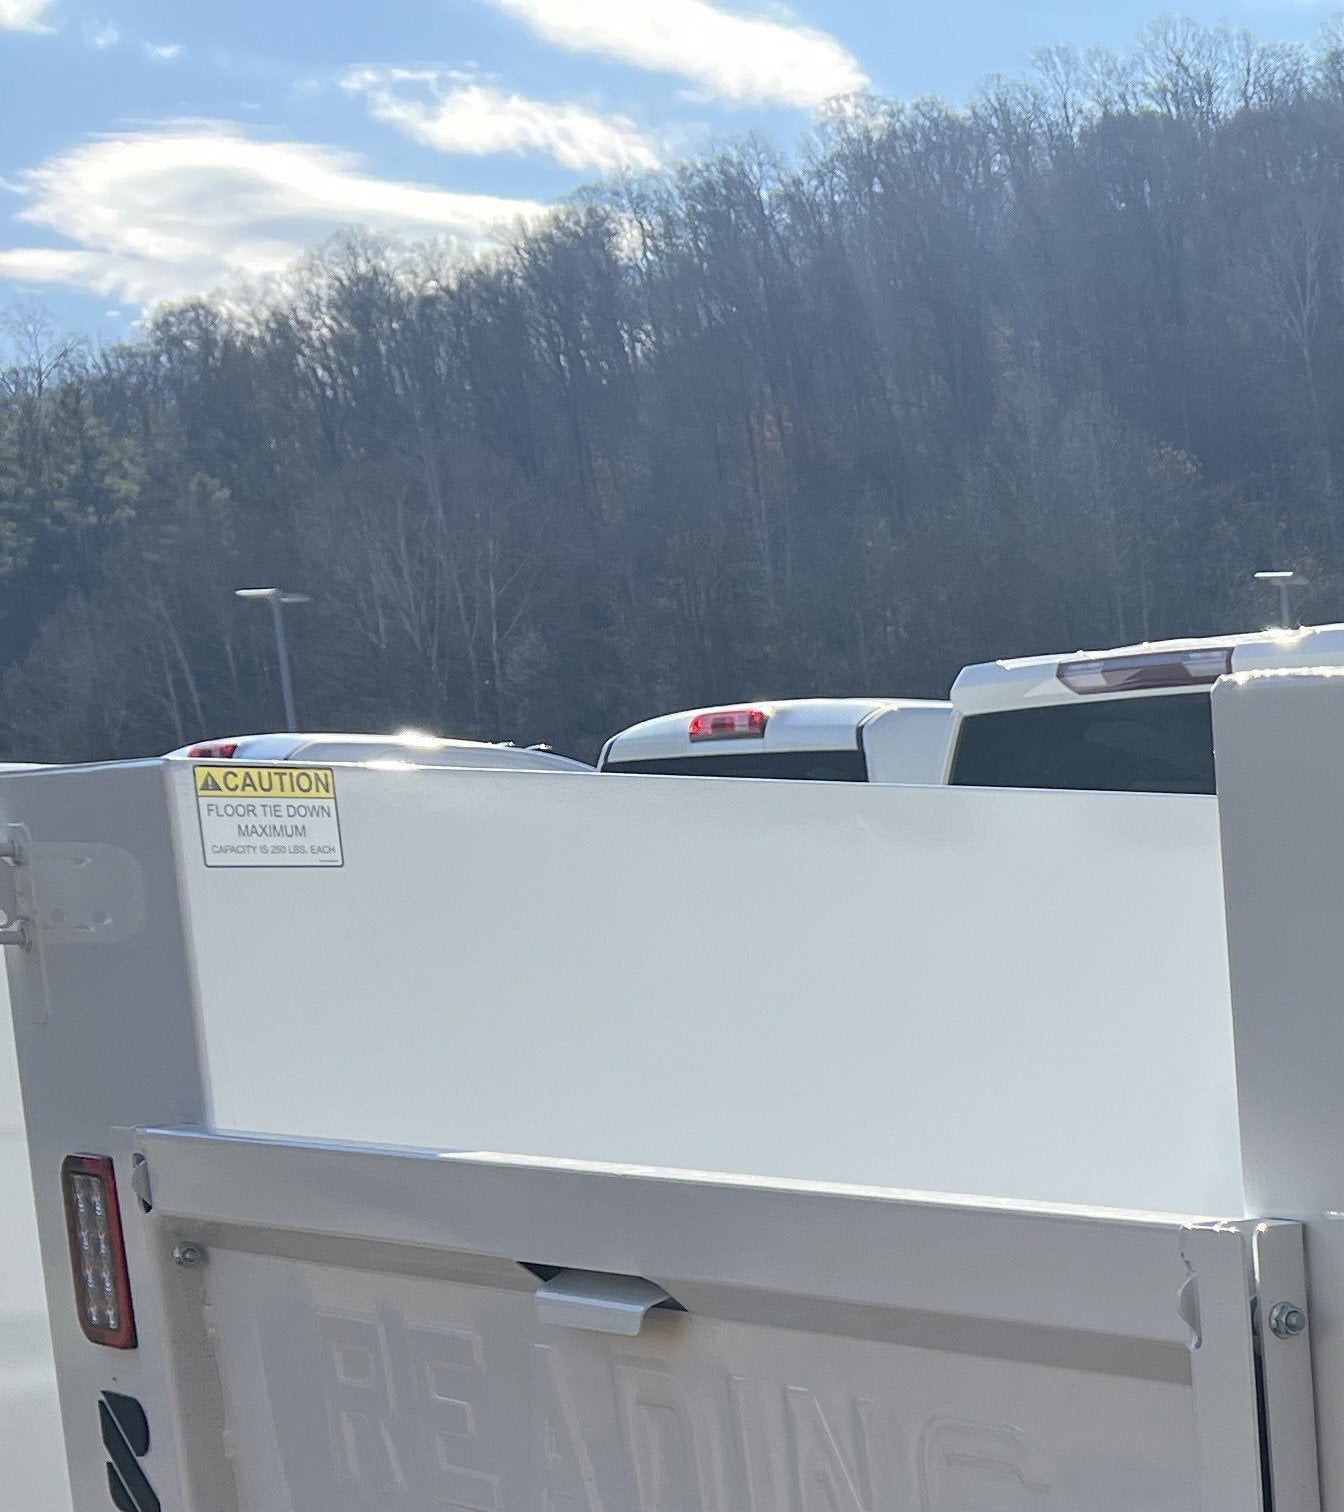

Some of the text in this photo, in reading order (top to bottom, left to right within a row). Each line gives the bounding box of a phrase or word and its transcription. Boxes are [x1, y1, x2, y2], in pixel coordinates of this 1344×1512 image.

[223, 770, 330, 793] CAUTION
[206, 803, 331, 819] FLOOR TIE DOWN
[237, 824, 307, 838] MAXIMUM
[211, 844, 256, 855] CAPACITY
[259, 845, 269, 855] IS
[310, 846, 336, 856] EACH
